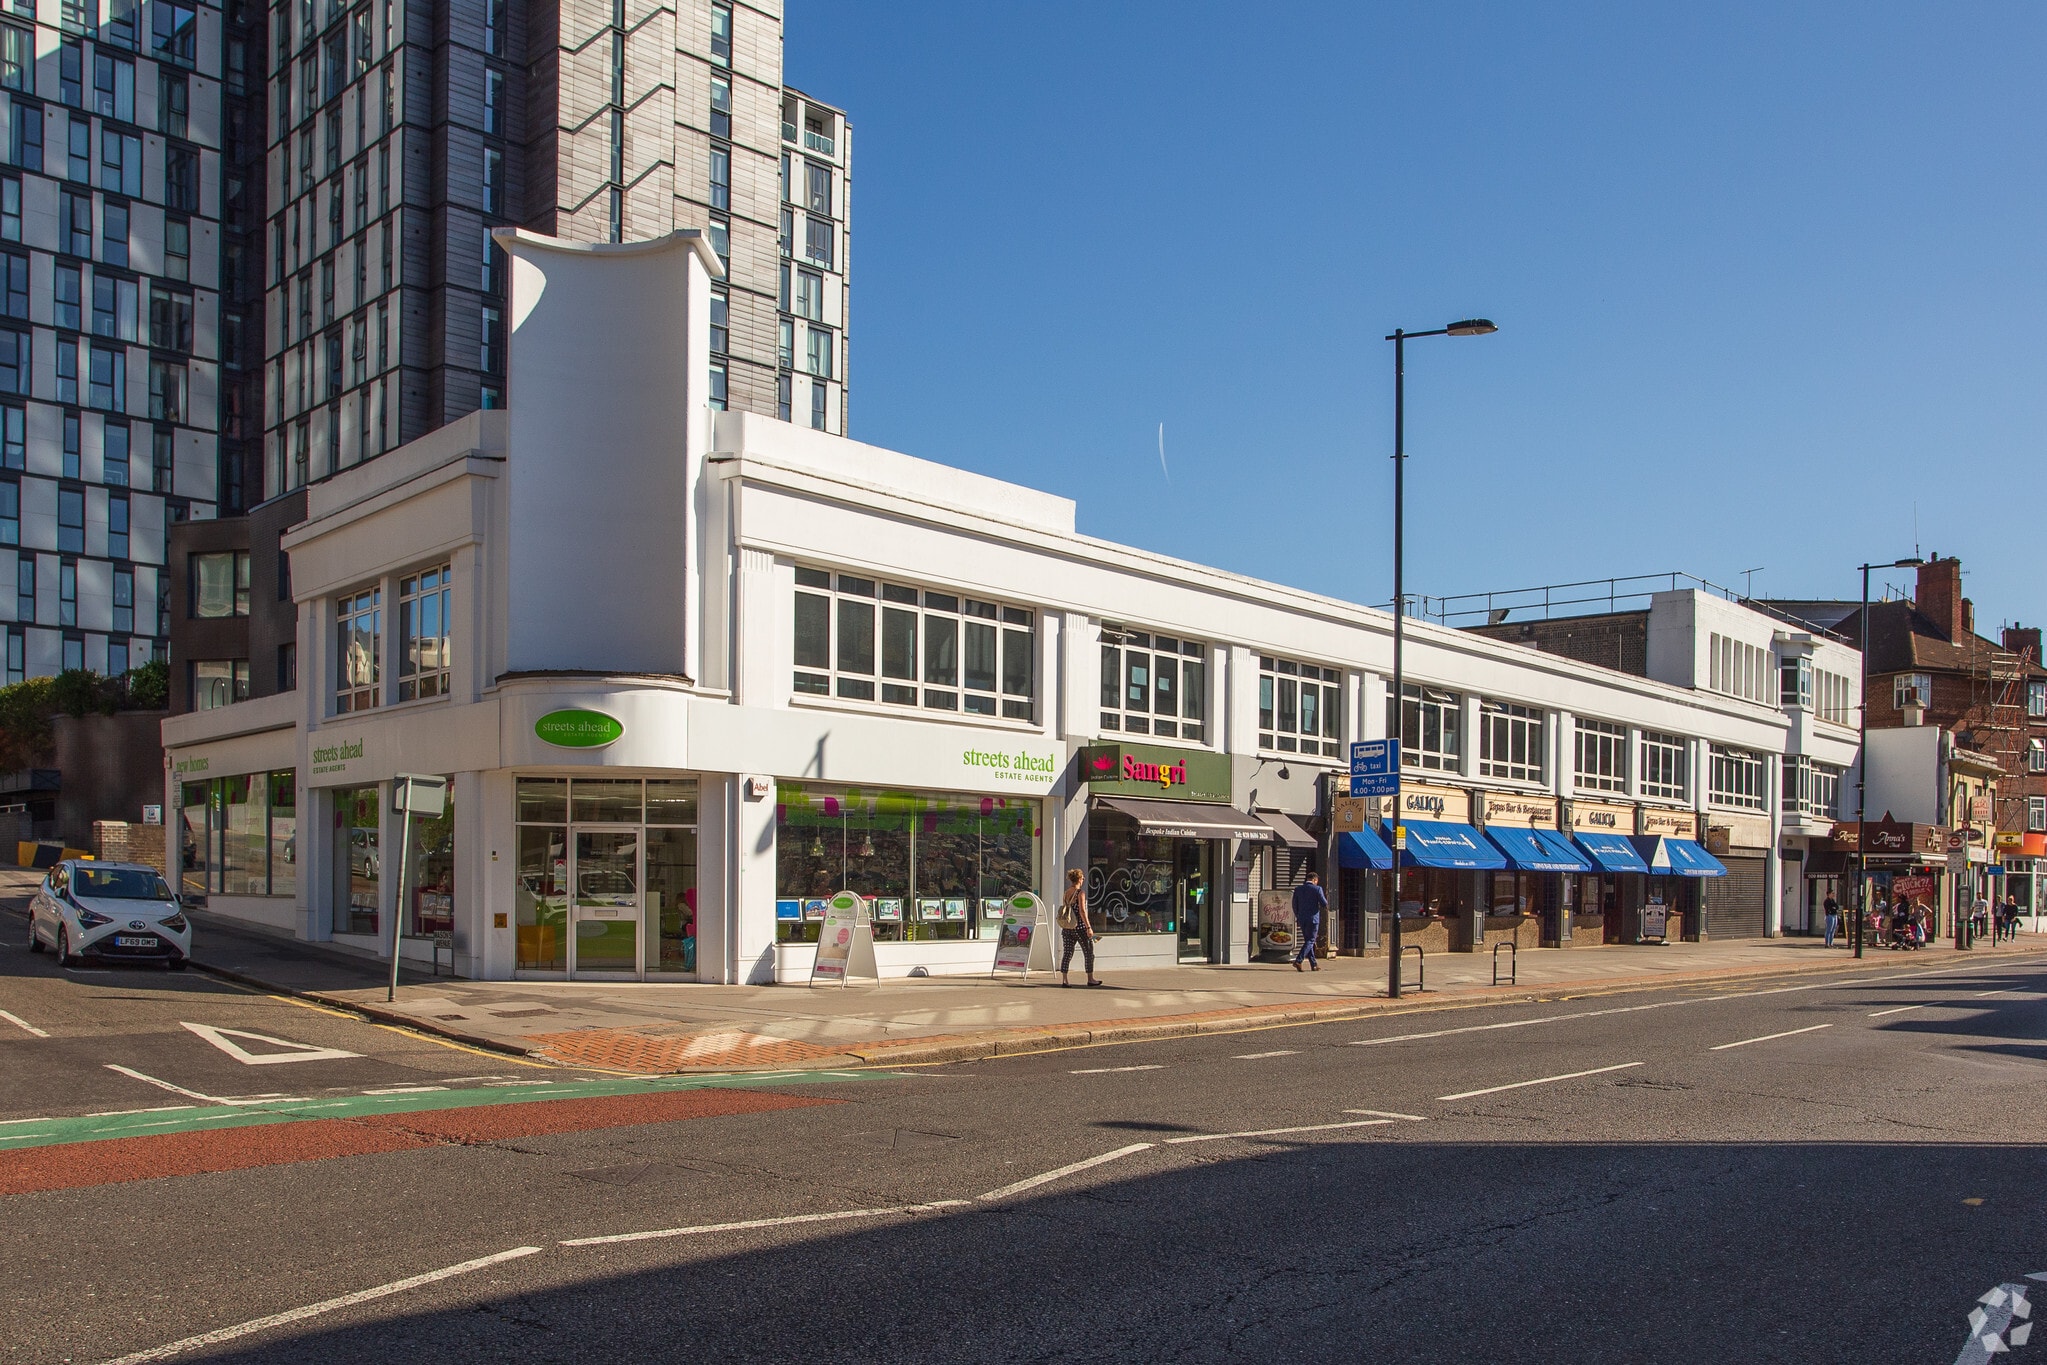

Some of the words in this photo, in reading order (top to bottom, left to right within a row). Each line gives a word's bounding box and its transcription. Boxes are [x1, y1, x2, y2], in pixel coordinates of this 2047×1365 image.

[543, 722, 575, 732] streets
[578, 721, 610, 732] ahead
[313, 746, 338, 764] streets
[340, 737, 363, 760] ahead
[190, 755, 209, 772] homes
[963, 748, 1010, 769] streets
[1014, 751, 1055, 772] ahead
[1370, 762, 1381, 770] taxi
[313, 766, 328, 774] ESTATE
[1123, 754, 1187, 789] Sangri
[995, 772, 1022, 780] ESTATE
[1025, 774, 1053, 783] AGENTS
[1407, 794, 1445, 812] GALICIA
[1489, 801, 1505, 815] Tapas
[1506, 803, 1516, 813] Bar
[1589, 812, 1616, 827] GALICIA
[1180, 829, 1197, 837] Cuisine
[1834, 831, 1859, 841] Anna
[1872, 832, 1905, 845] Anna's
